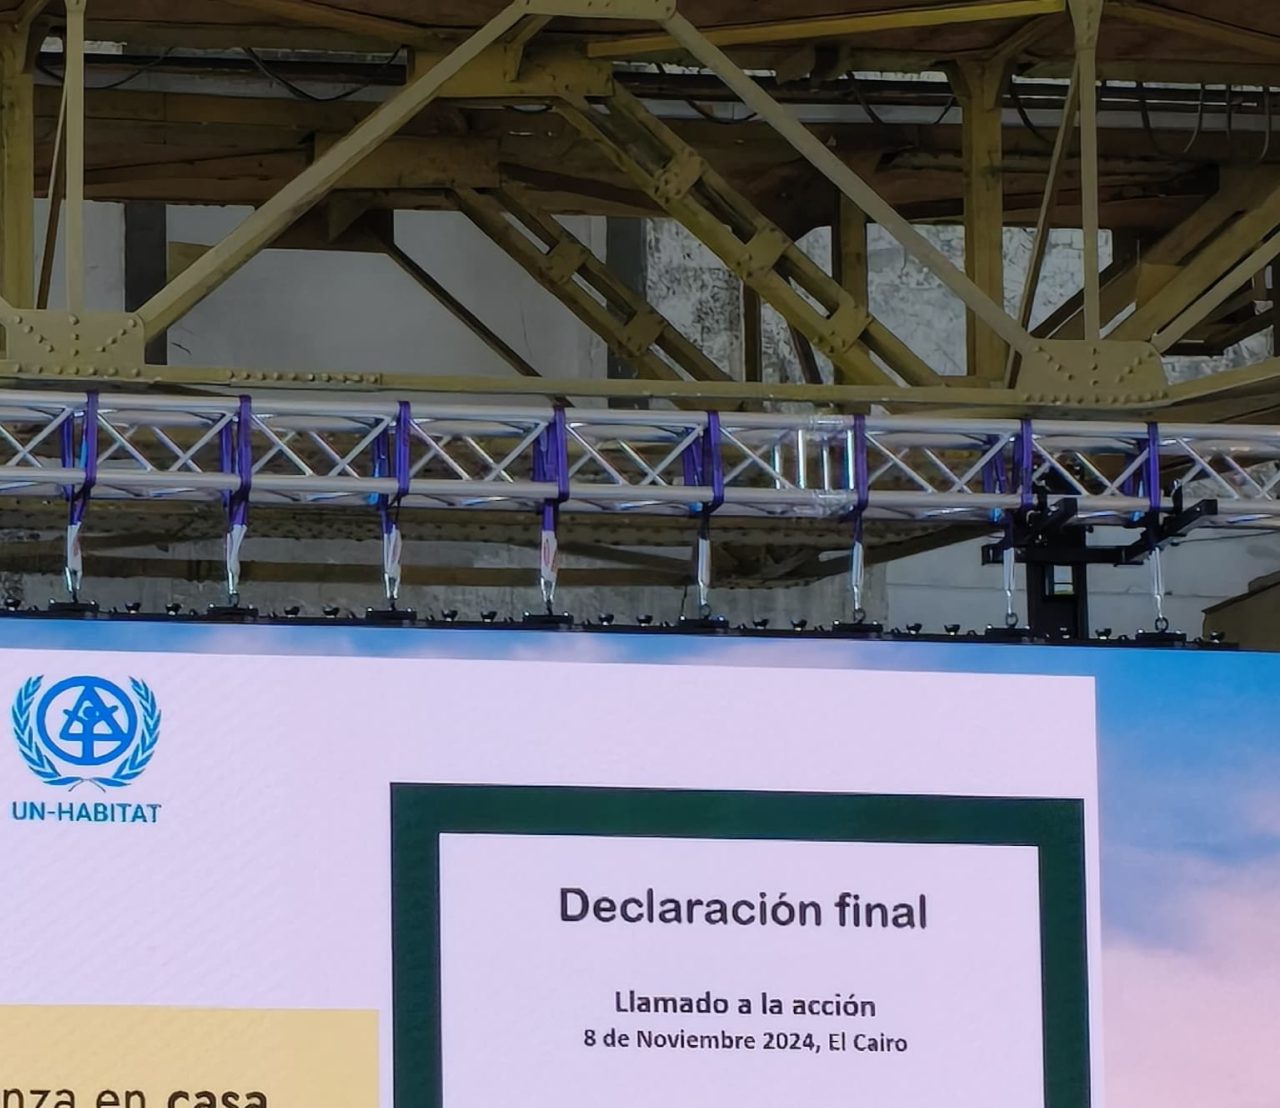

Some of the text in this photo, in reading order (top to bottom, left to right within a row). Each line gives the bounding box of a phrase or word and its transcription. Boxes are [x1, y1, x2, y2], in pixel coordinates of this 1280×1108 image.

[12, 801, 162, 824] UN-HABITAT
[560, 887, 927, 930] Declaración final
[615, 989, 876, 1017] Llamado a la acción
[583, 1027, 908, 1054] 8 de Noviembre 2024, El Cairo
